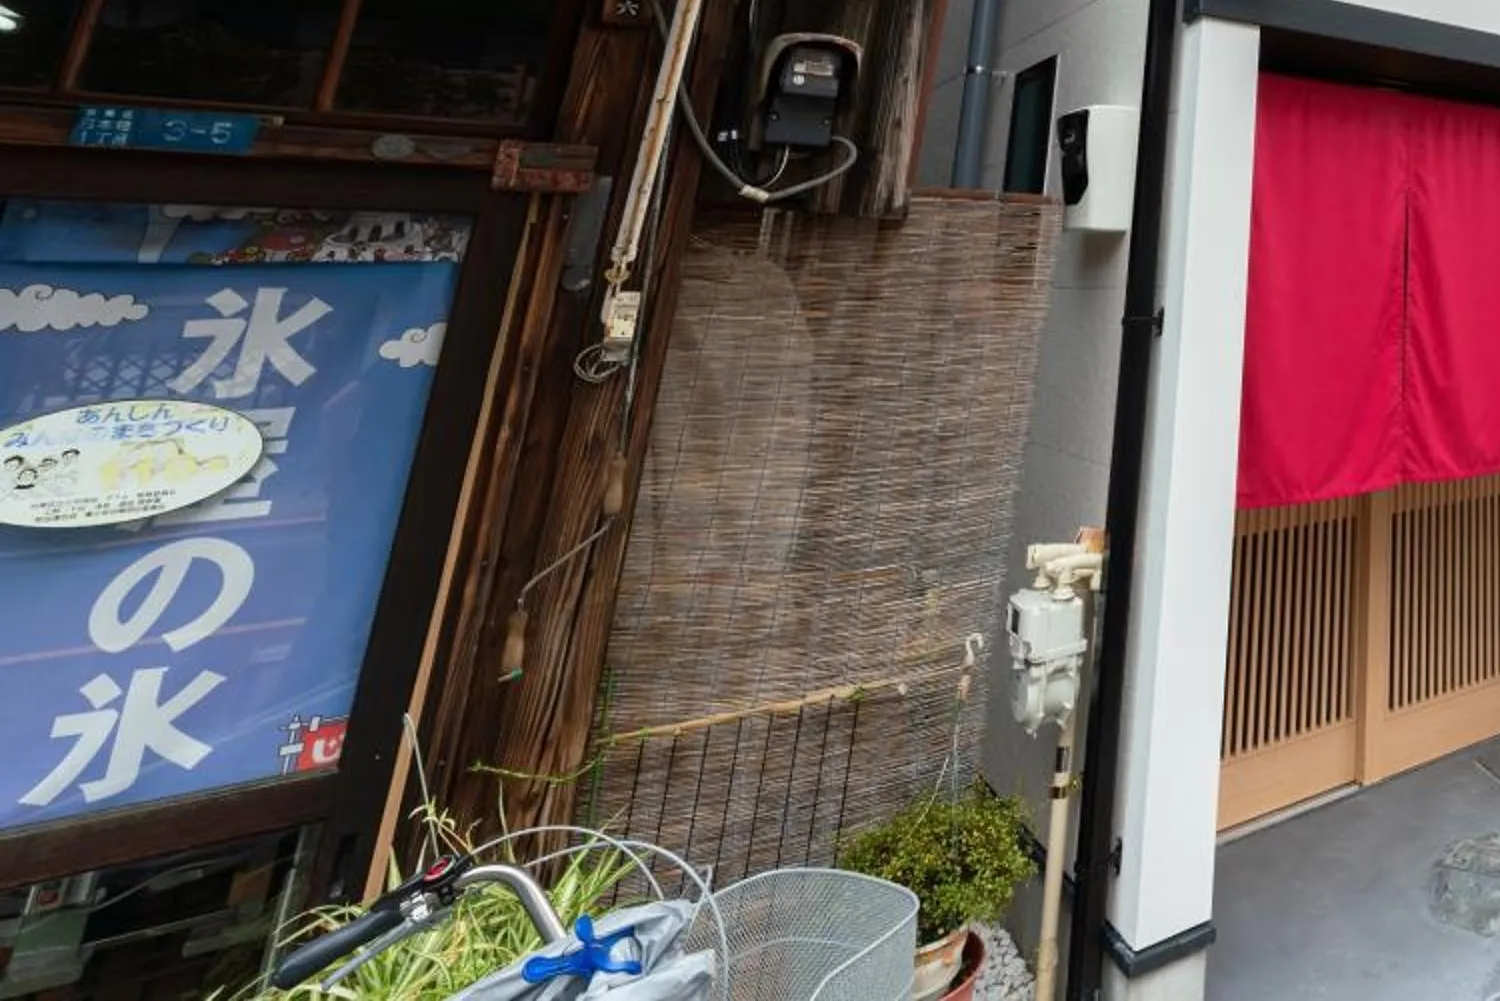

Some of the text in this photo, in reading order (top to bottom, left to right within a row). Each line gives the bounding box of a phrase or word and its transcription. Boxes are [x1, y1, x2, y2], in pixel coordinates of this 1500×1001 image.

[162, 118, 233, 145] 3-5
[77, 403, 170, 423] あんしん
